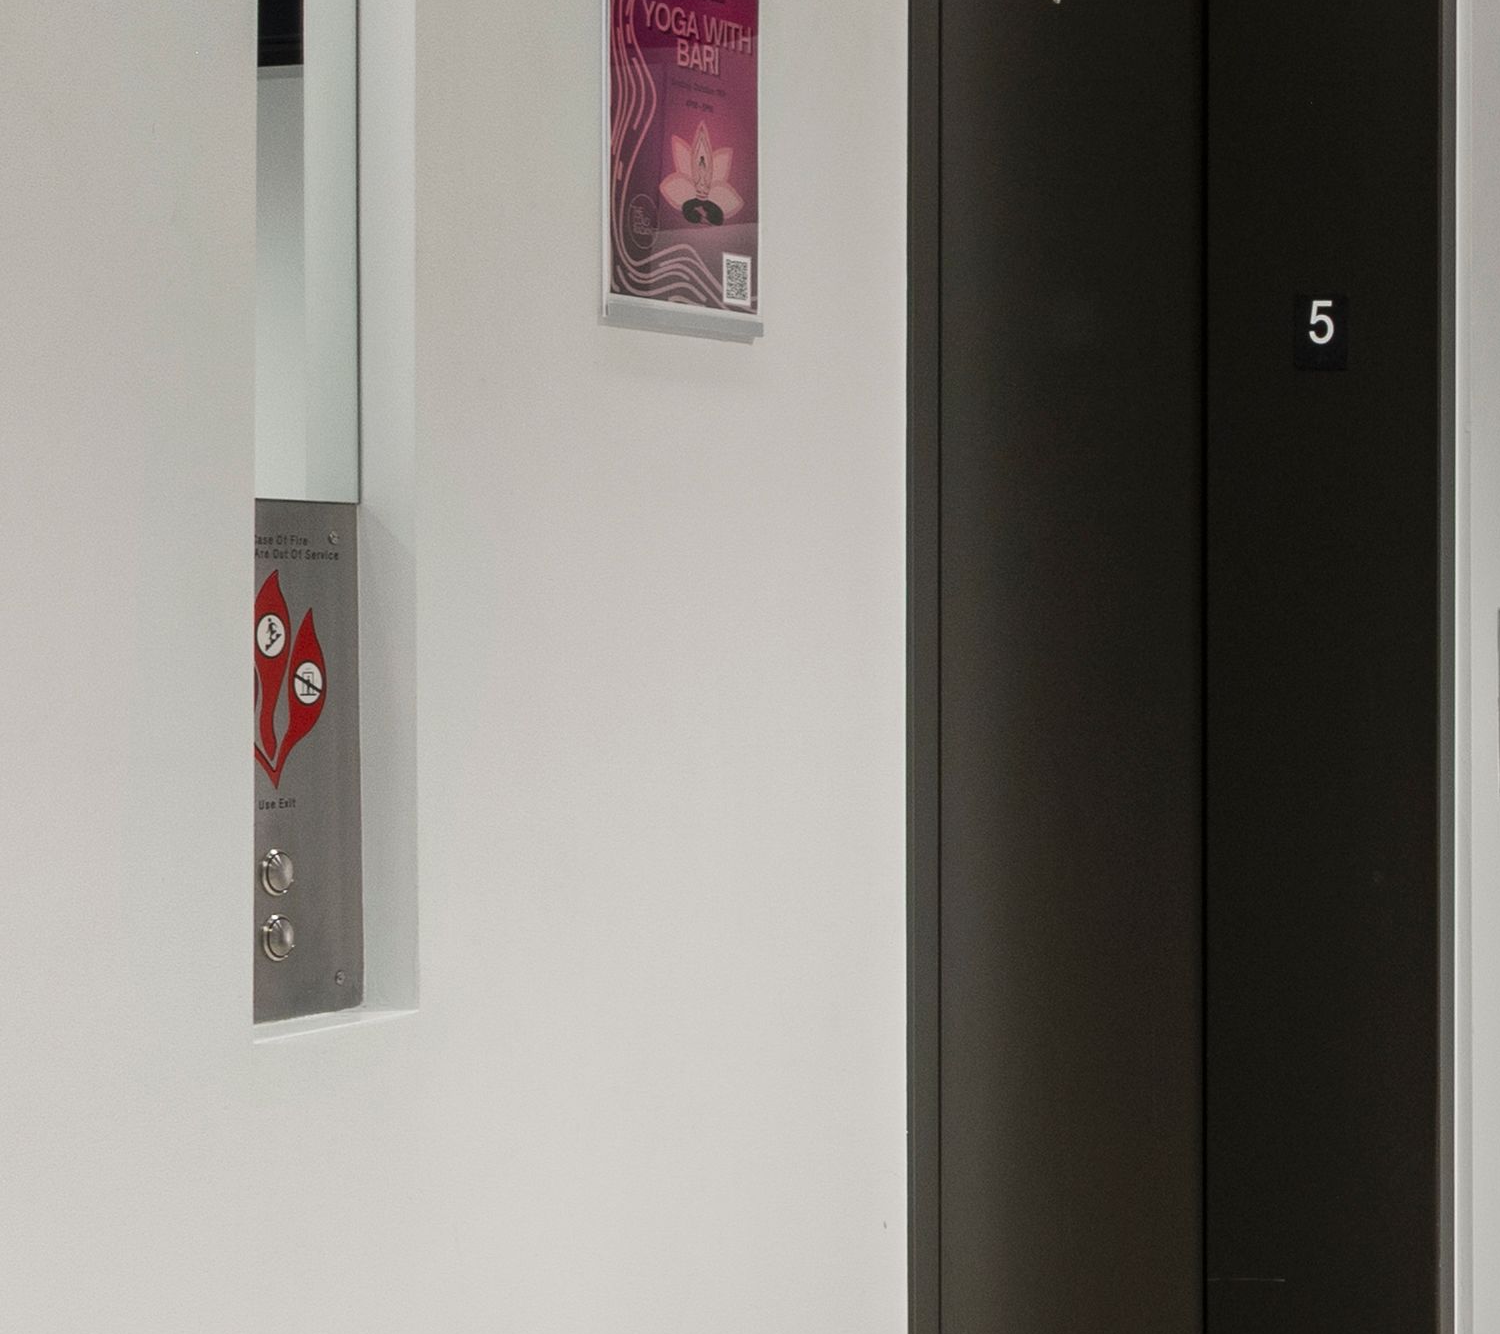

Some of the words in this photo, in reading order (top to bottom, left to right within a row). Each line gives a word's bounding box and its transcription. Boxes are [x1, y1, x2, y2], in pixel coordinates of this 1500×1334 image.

[703, 14, 753, 54] WITH
[676, 38, 721, 76] BARI
[1308, 300, 1335, 345] 5
[289, 534, 308, 546] Fire
[272, 549, 289, 560] Out
[304, 549, 339, 561] Service
[258, 799, 276, 811] Use
[278, 798, 296, 809] Exit
